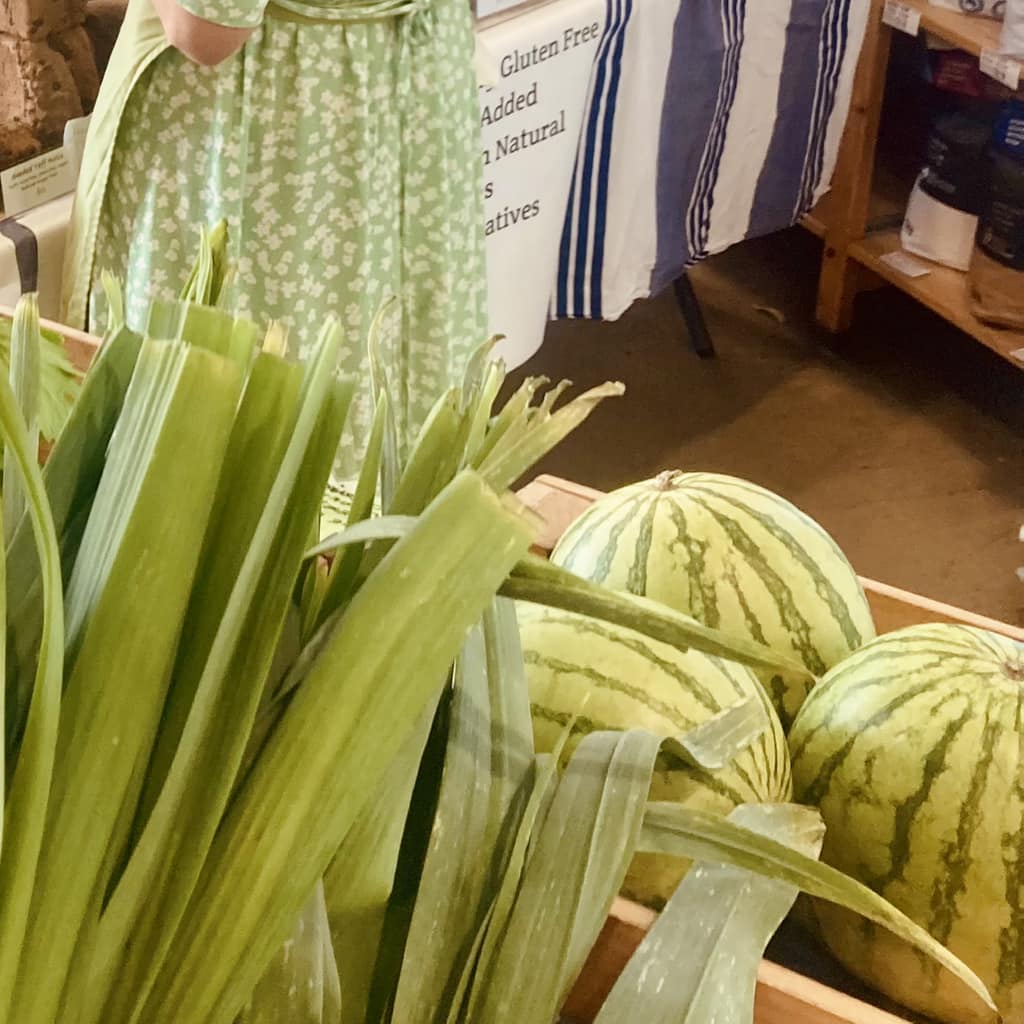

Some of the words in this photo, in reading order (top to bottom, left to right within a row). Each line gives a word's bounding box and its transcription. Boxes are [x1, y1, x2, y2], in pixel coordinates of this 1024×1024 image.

[500, 40, 560, 78] Gluten
[563, 22, 599, 52] Free
[480, 82, 538, 127] Added
[495, 109, 565, 161] Natural
